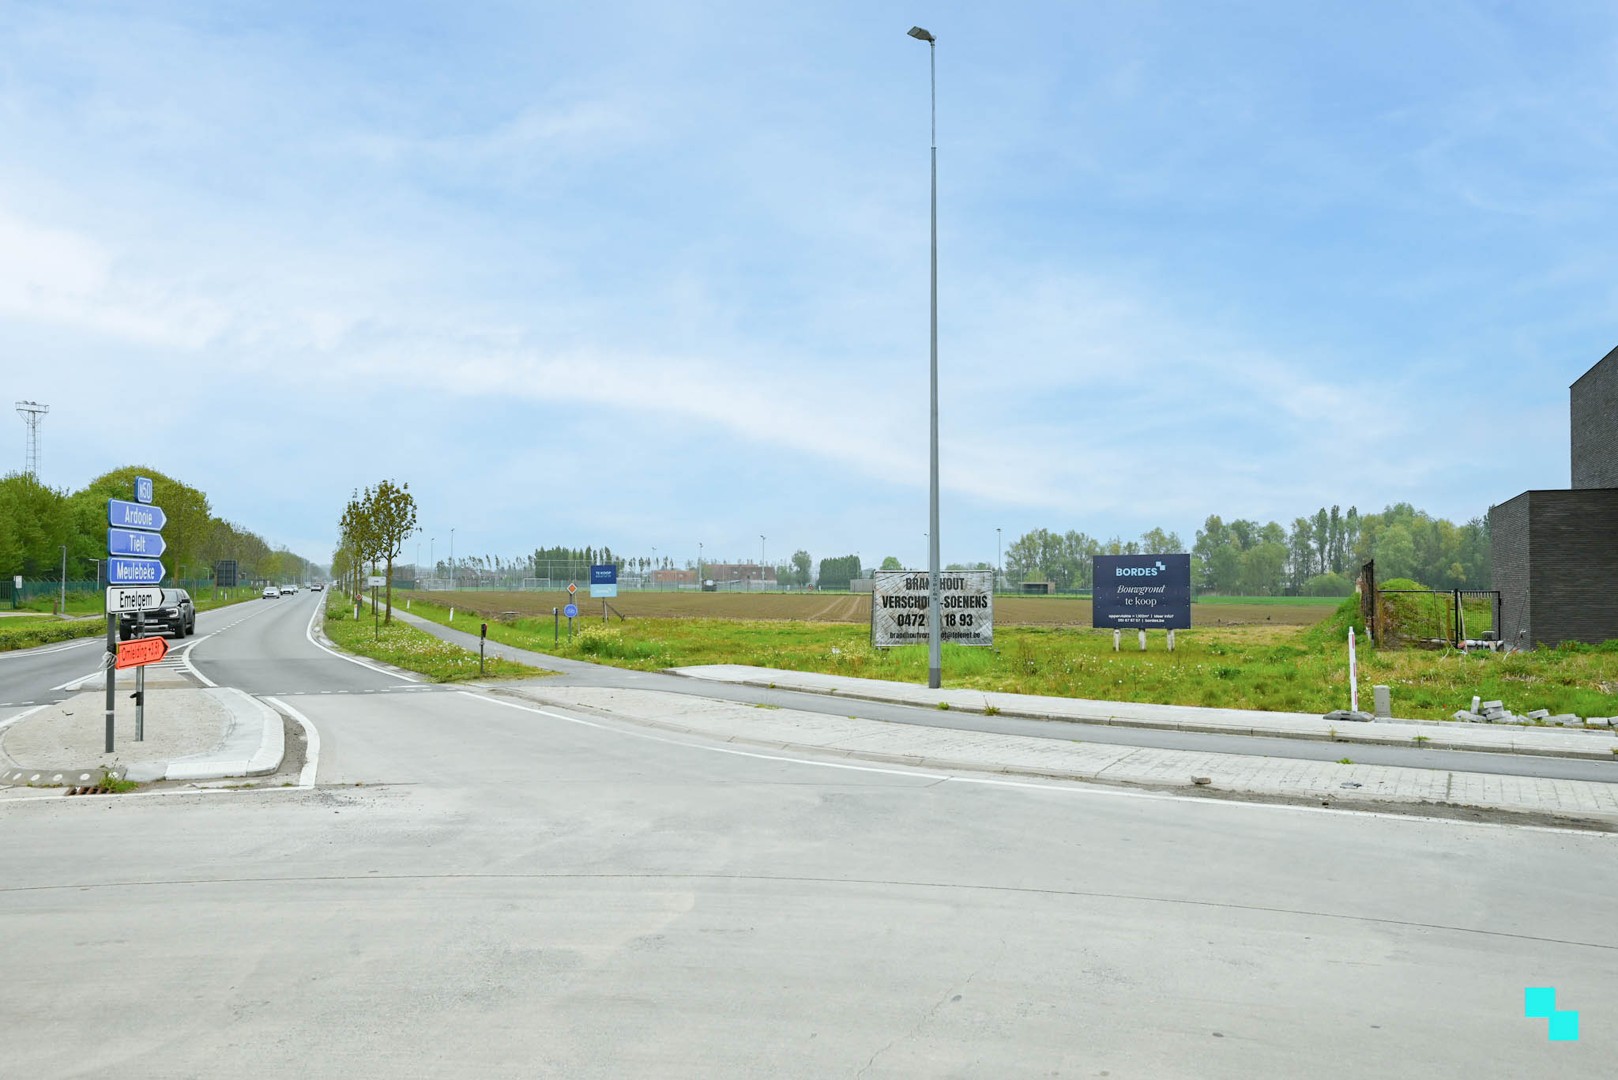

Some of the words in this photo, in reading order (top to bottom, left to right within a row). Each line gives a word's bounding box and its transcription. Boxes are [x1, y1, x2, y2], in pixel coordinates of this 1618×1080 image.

[140, 482, 151, 500] N50
[124, 505, 152, 526] Ardooie
[130, 534, 146, 552] Tielt
[116, 562, 154, 580] Meulebeke
[1116, 568, 1158, 576] BORDES
[906, 578, 964, 590] BRANHOUT
[1117, 584, 1166, 595] Bouwgrond
[120, 590, 152, 611] Emelgem
[882, 596, 988, 608] VERSCHO-SOENENS
[1135, 596, 1157, 607] koop
[897, 614, 925, 626] 0472
[944, 614, 956, 626] 18
[960, 614, 973, 626] 93
